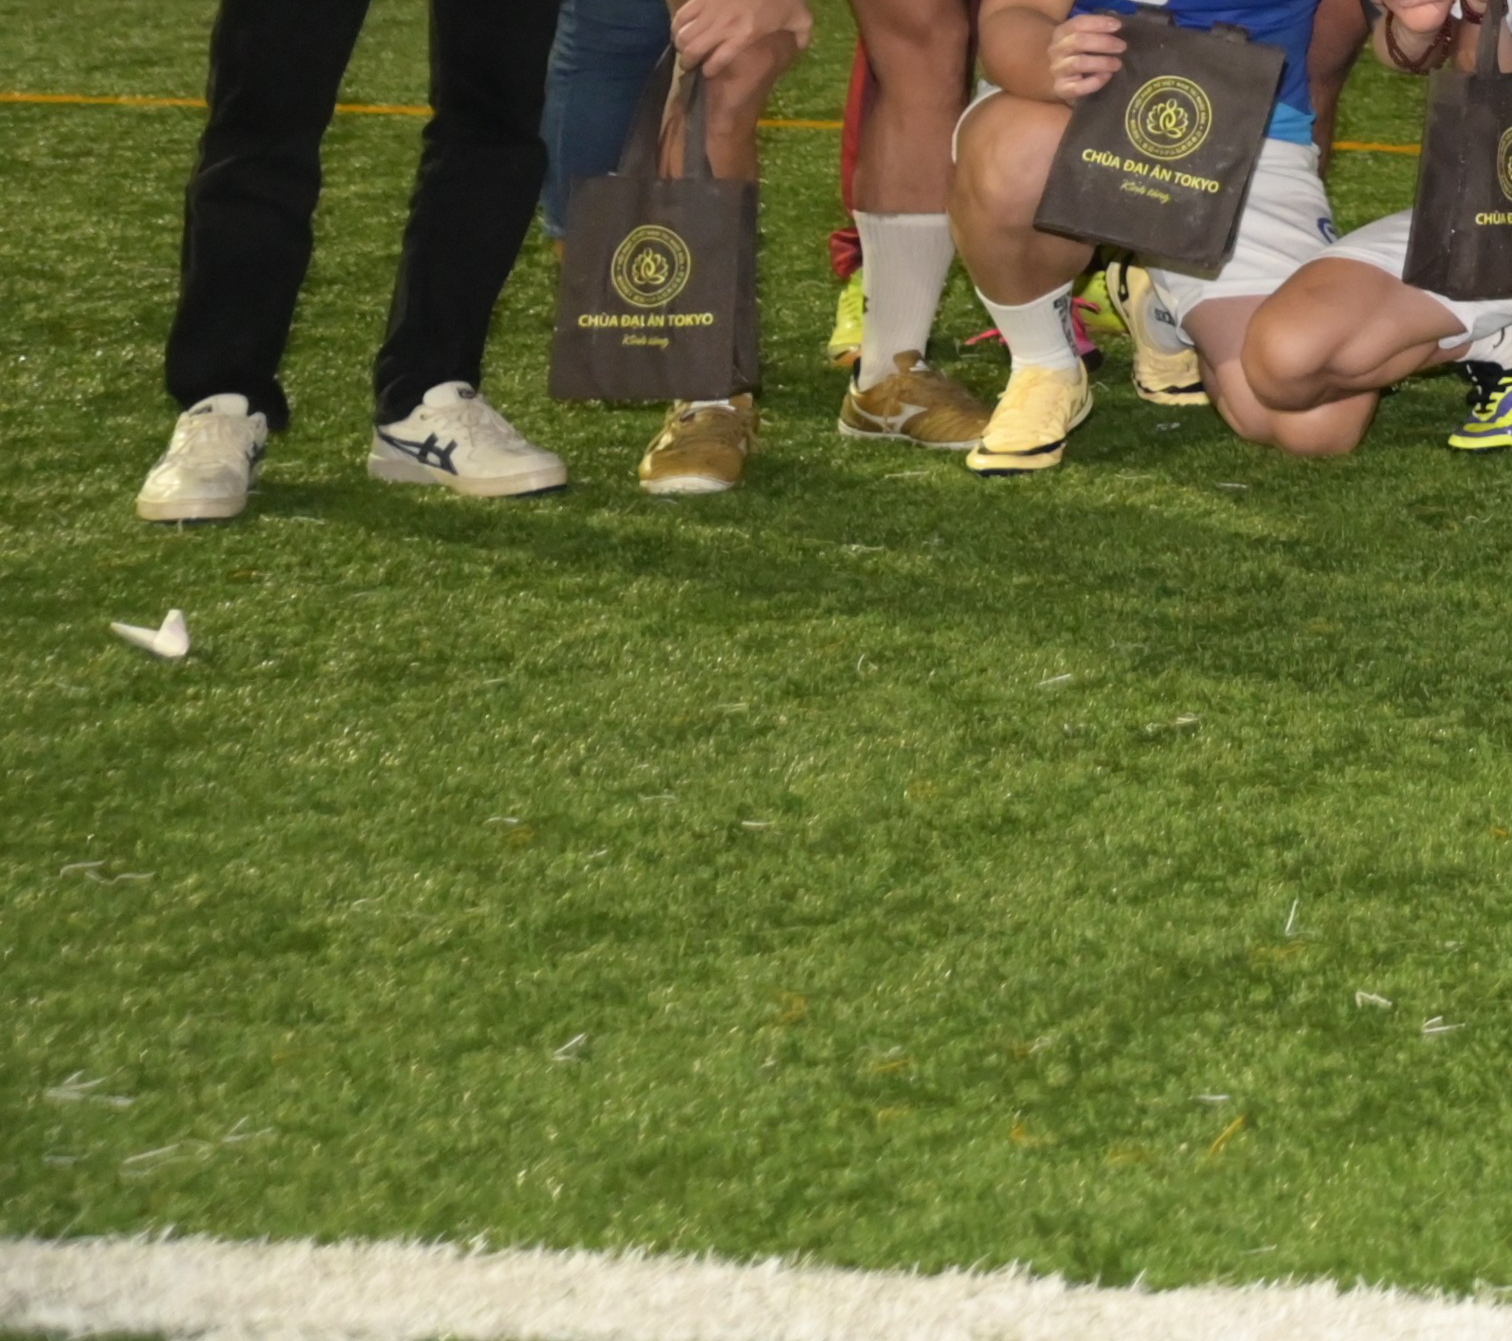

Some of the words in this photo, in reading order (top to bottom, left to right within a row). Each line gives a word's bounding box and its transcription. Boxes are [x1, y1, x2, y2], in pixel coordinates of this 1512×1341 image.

[1081, 148, 1121, 170] CHÙA
[1150, 163, 1173, 182] ÂN
[1174, 171, 1220, 194] TOKYO
[578, 311, 618, 328] CHÙA
[667, 312, 715, 327] TOKYO
